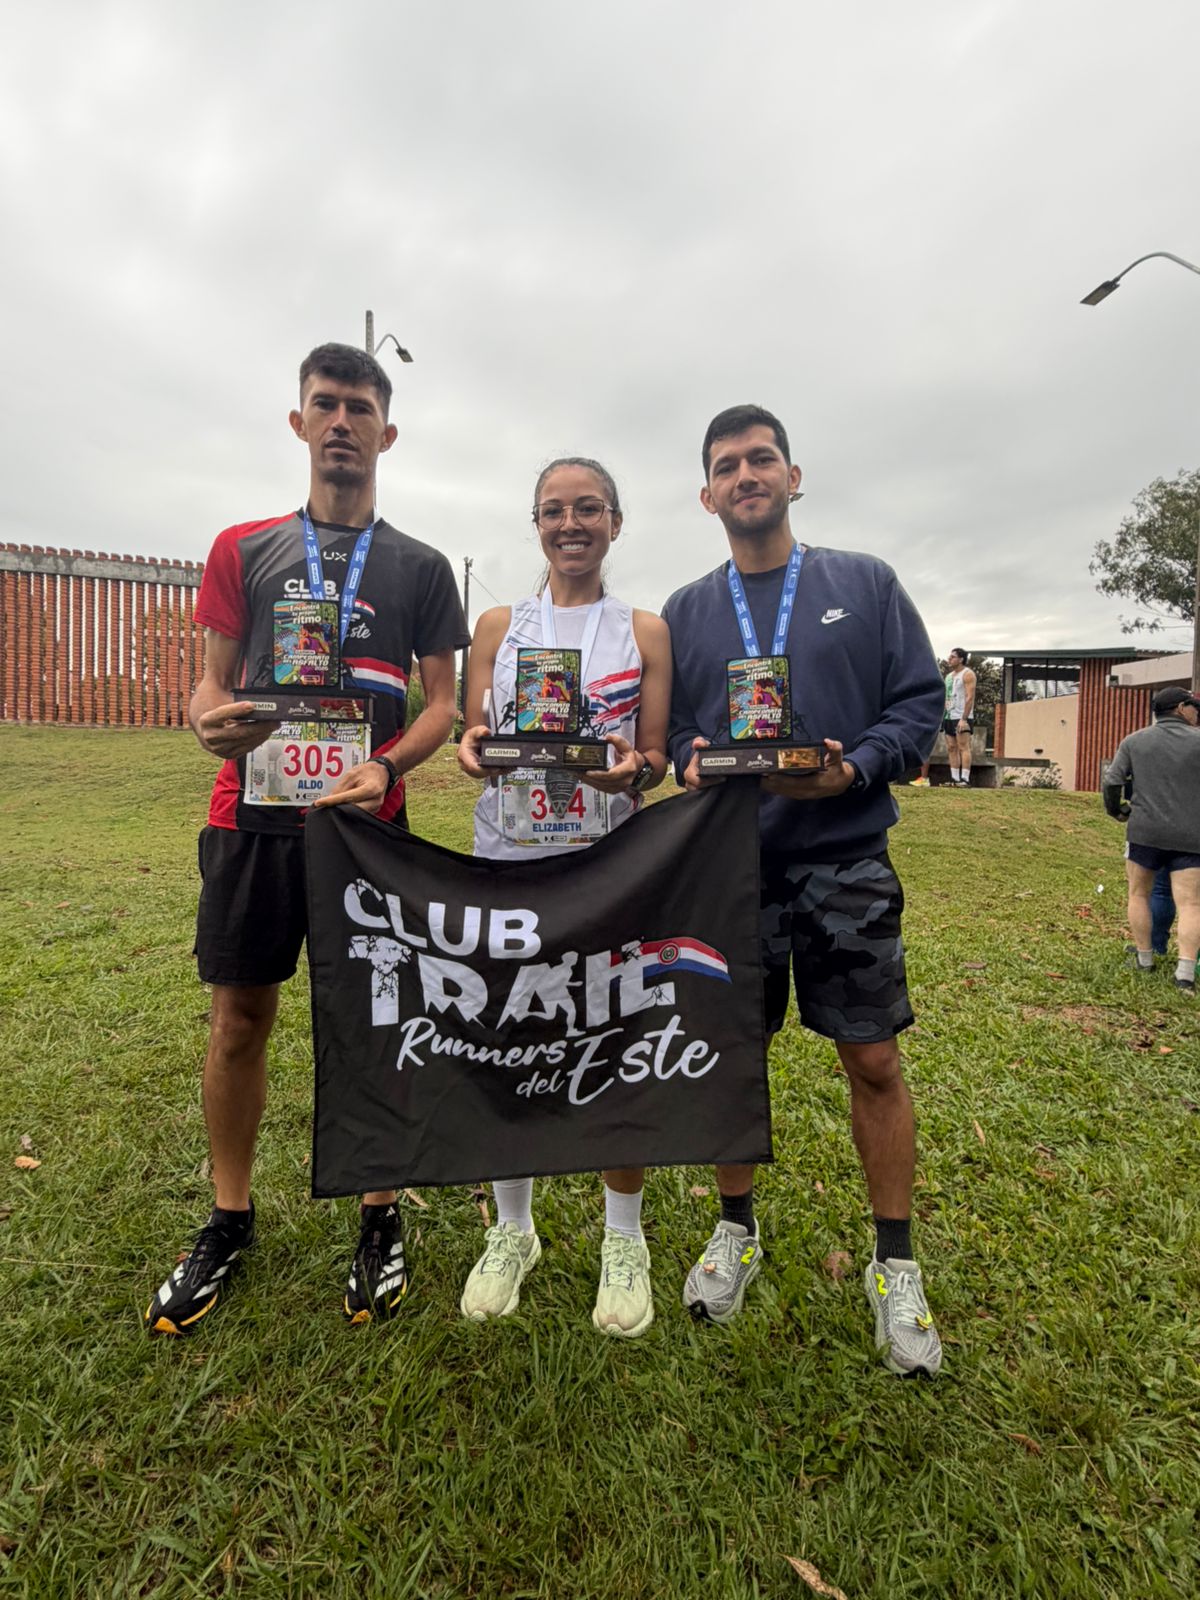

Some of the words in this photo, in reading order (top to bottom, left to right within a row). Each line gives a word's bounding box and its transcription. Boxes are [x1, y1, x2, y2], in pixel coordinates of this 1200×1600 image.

[323, 551, 348, 562] UX
[284, 578, 337, 596] CLB
[826, 608, 844, 618] NIKE
[293, 615, 322, 624] ritmo
[346, 622, 373, 639] ste
[292, 658, 329, 667] ASFALTO
[536, 664, 564, 673] ritmo
[747, 671, 774, 681] ritmo
[337, 734, 362, 742] ritmo
[283, 744, 345, 778] 305
[297, 780, 323, 790] ALDO
[531, 787, 586, 820] 34
[532, 823, 582, 833] ELIZABETH
[343, 877, 541, 960] CLUB
[348, 936, 676, 1037] TRAIL
[396, 1017, 568, 1070] Runners
[516, 1069, 565, 1099] del
[567, 1014, 720, 1106] Este
